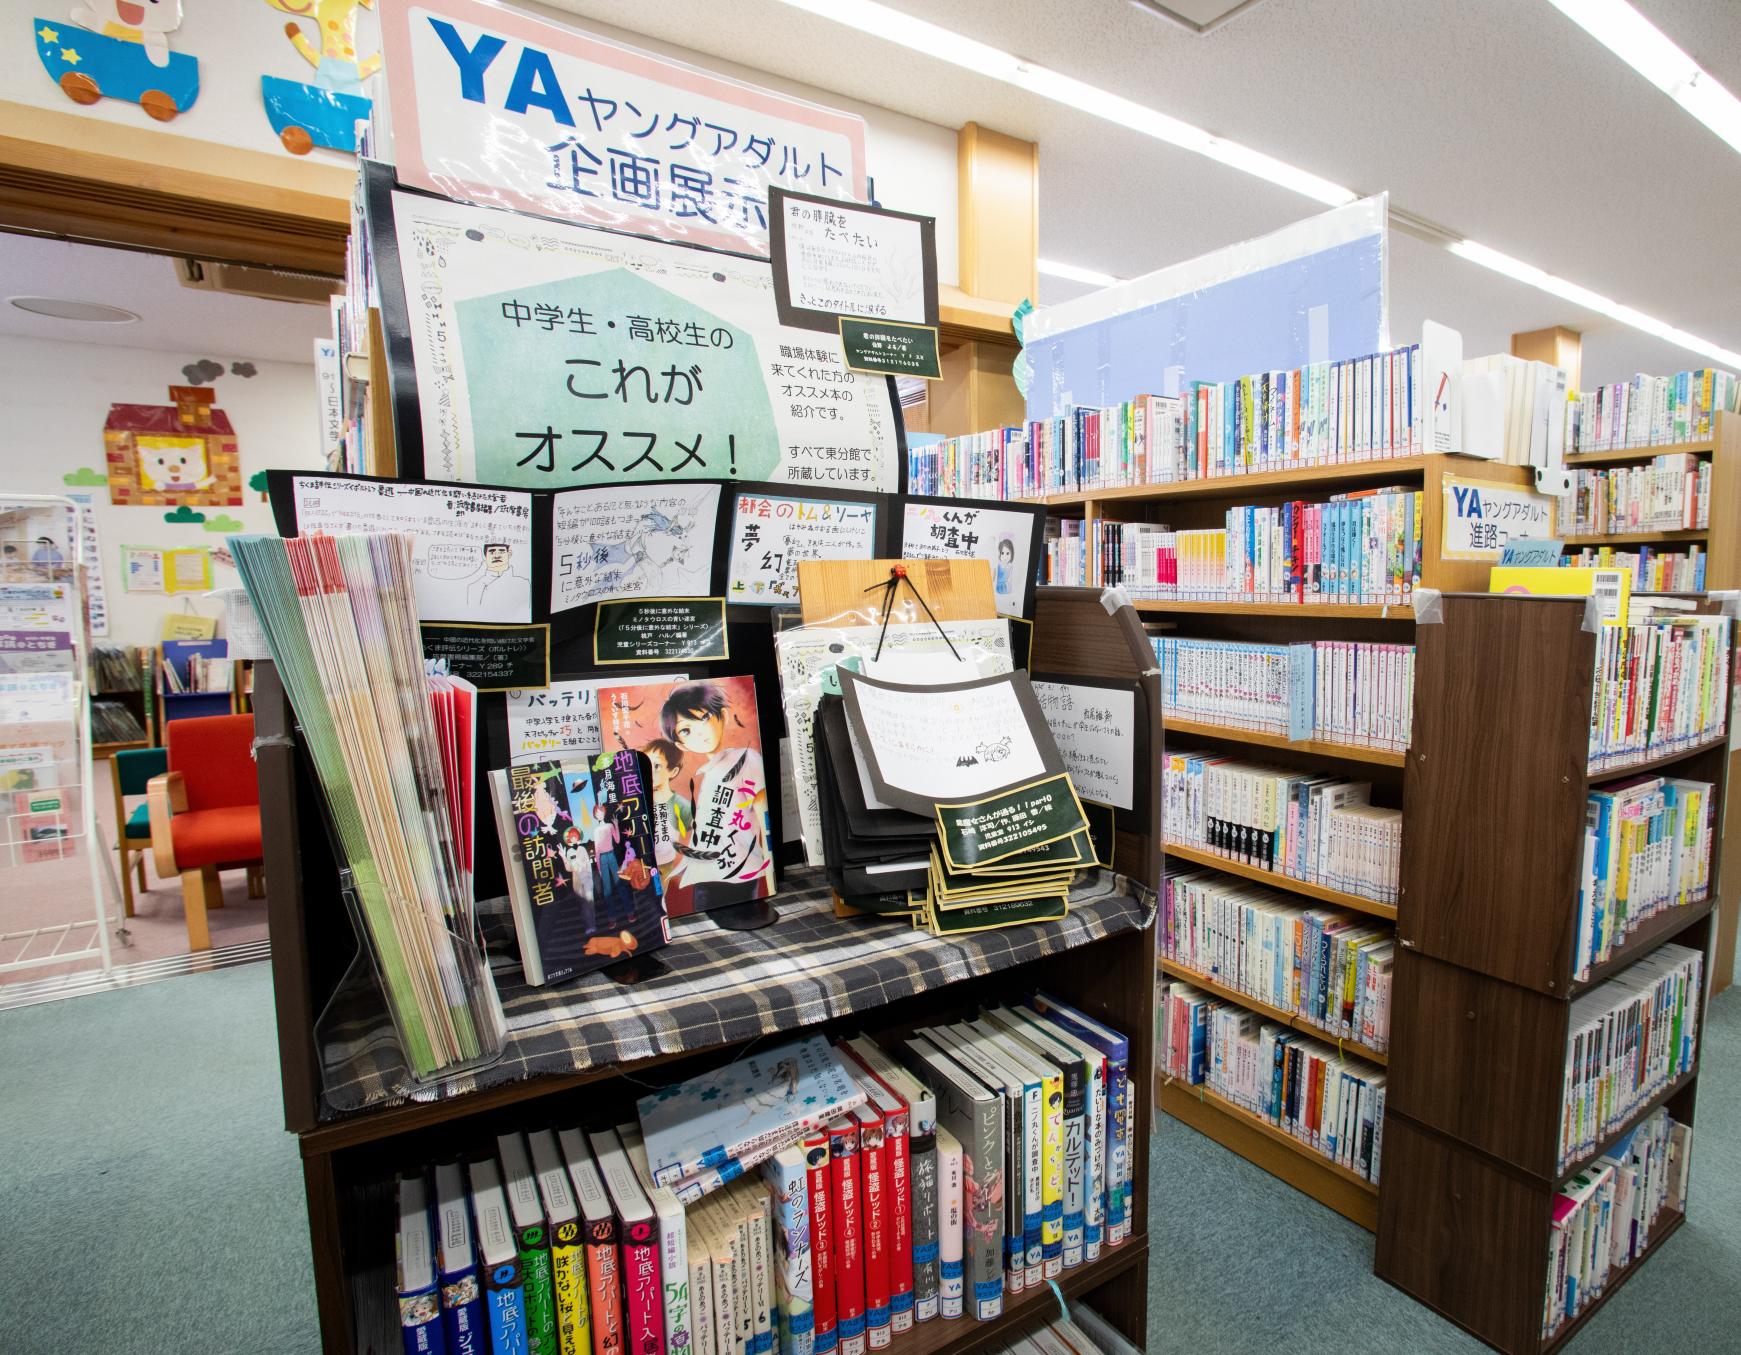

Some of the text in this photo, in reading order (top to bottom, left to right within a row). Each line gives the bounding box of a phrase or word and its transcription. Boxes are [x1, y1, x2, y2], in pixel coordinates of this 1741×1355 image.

[427, 17, 844, 187] YA ヤングアダルト
[825, 227, 878, 248] たべたい
[502, 301, 734, 350] 中学生・高校生の
[779, 345, 840, 363] 職場体験に
[564, 358, 704, 405] これが
[771, 363, 855, 383] 来てくれた方の
[781, 384, 853, 401] オススメ本の
[790, 404, 844, 420] 紹介です。
[515, 425, 739, 474] オススメ！
[788, 445, 871, 461] すべて東分館で
[787, 466, 876, 481] 所蔵しています。
[1453, 486, 1549, 522] YA ヤングアダルト
[741, 524, 761, 552] 夢
[930, 523, 979, 550] 調査中
[560, 547, 609, 577] 5秒後
[760, 550, 783, 574] 幻
[1501, 549, 1515, 564] YA
[561, 569, 622, 593] に意外な結末
[527, 689, 597, 708] バッテリ
[613, 749, 651, 880] 地底アパート
[658, 802, 671, 842] 天狗さまの
[699, 784, 735, 849] 調査中
[716, 779, 757, 870] 二ノ丸くんが
[508, 766, 555, 907] 最後の訪問者
[1006, 823, 1021, 833] 913
[1031, 1090, 1038, 1100] F
[1031, 1107, 1039, 1172] 二ノ丸くんが調査中
[982, 1106, 999, 1218] ピンクとグレー
[1065, 1120, 1083, 1207] カルテット！
[1115, 1150, 1125, 1158] YA
[918, 1159, 937, 1241] 旅猫リポート
[787, 1175, 809, 1289] 虹のランナーズ
[1050, 1221, 1061, 1230] YA
[1068, 1234, 1079, 1242] YA
[1030, 1249, 1041, 1258] YA
[948, 1282, 961, 1292] YA
[758, 1311, 766, 1323] 6
